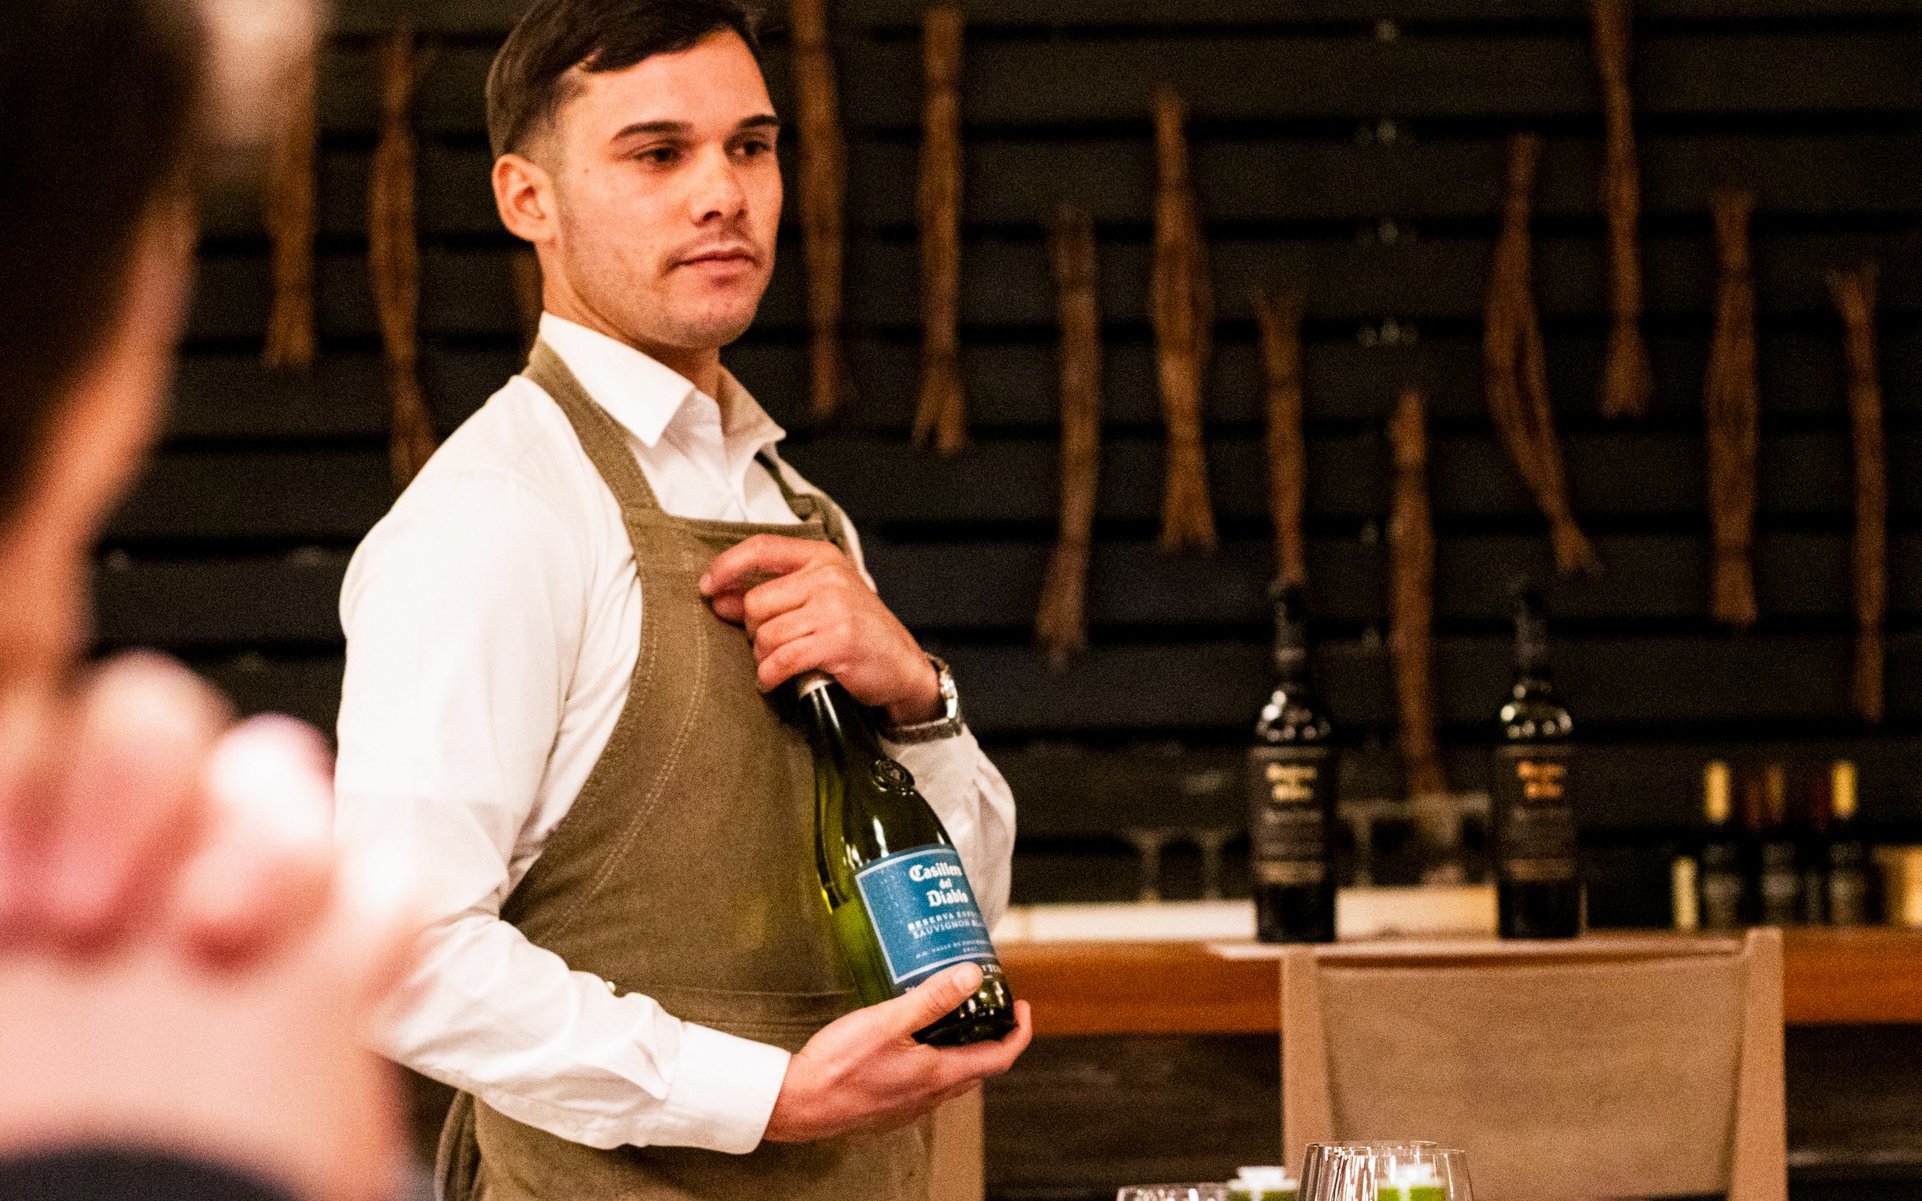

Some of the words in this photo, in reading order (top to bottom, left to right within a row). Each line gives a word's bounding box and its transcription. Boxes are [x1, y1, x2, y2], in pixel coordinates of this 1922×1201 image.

[939, 878, 952, 889] del
[926, 889, 969, 907] Diablo
[907, 912, 954, 931] RESERVA
[912, 919, 970, 939] SAUVIGNON
